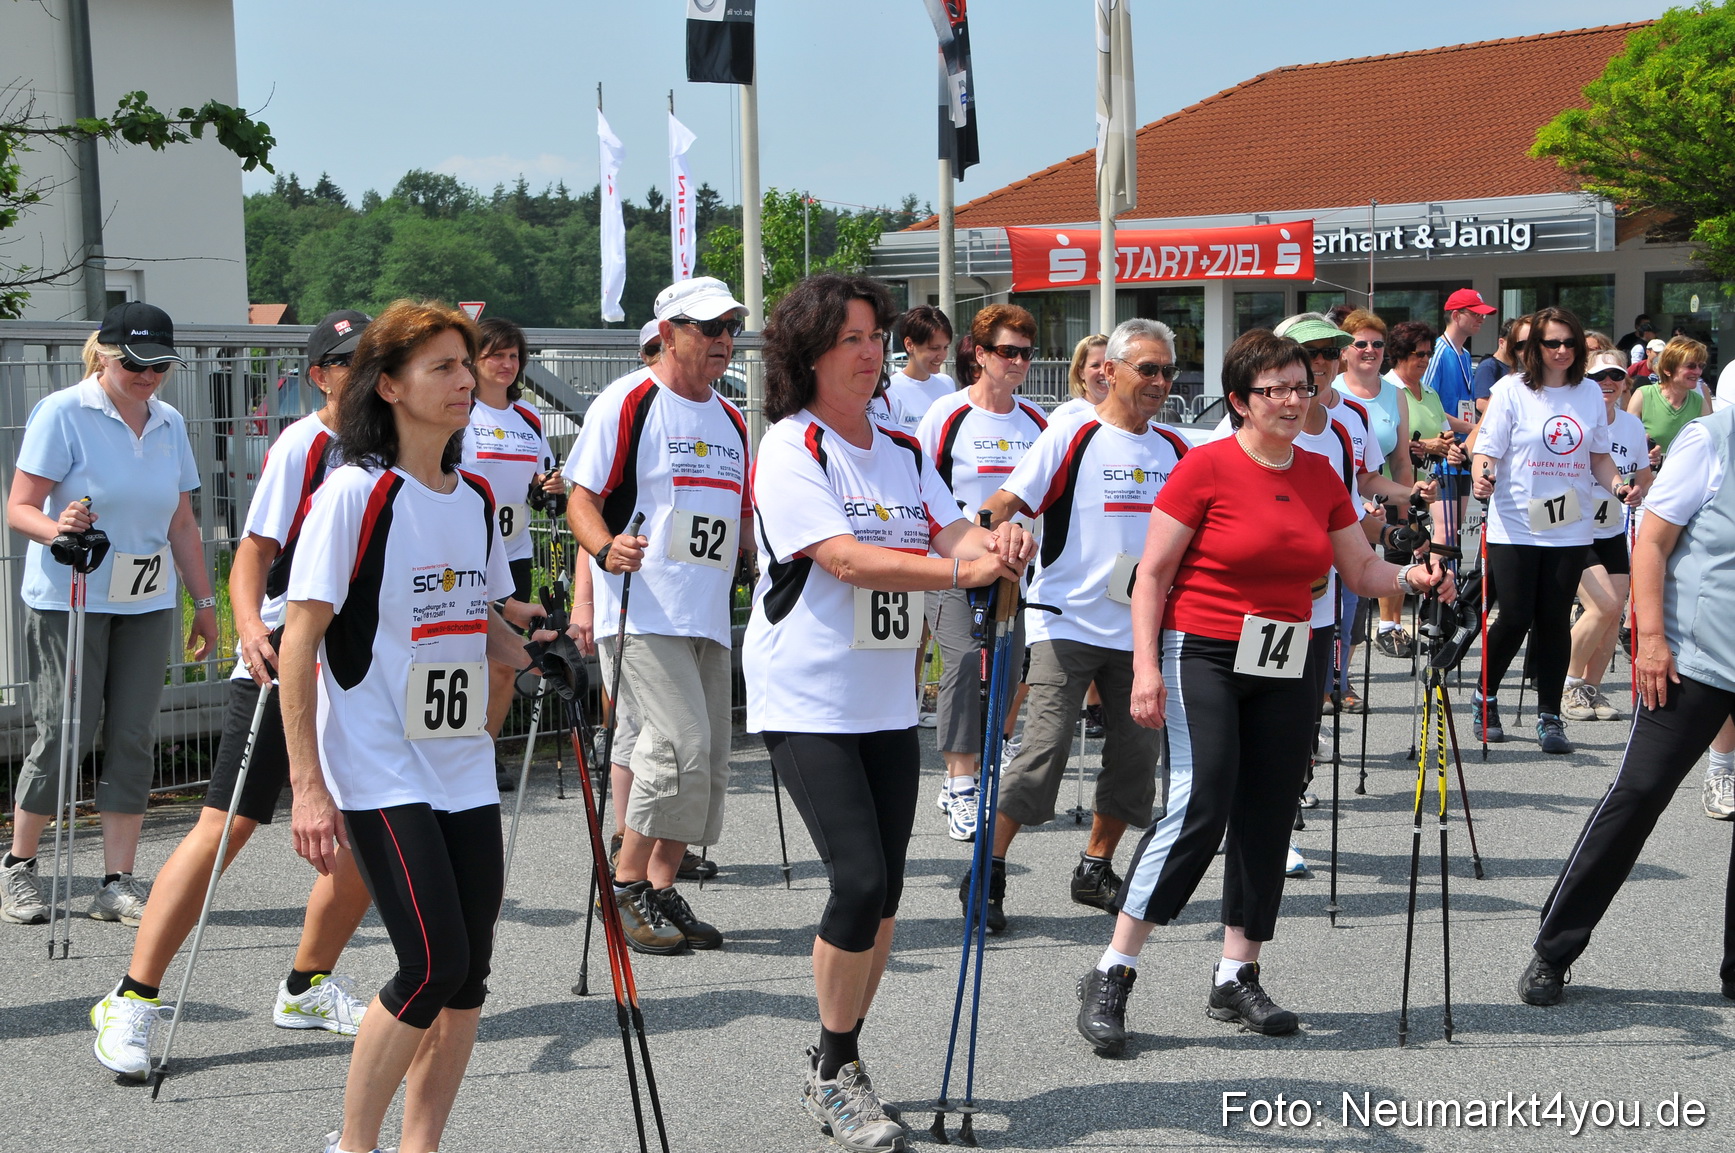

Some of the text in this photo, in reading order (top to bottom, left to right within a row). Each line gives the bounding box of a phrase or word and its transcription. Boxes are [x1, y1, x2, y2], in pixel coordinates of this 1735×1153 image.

[1414, 224, 1435, 249] &
[1445, 217, 1534, 250] Jänig
[1528, 459, 1555, 468] LAUFEN
[1544, 495, 1566, 524] 17
[690, 515, 726, 562] 52
[130, 555, 161, 595] 72
[871, 590, 909, 641] 63
[1257, 623, 1295, 670] 14
[424, 668, 469, 731] 56
